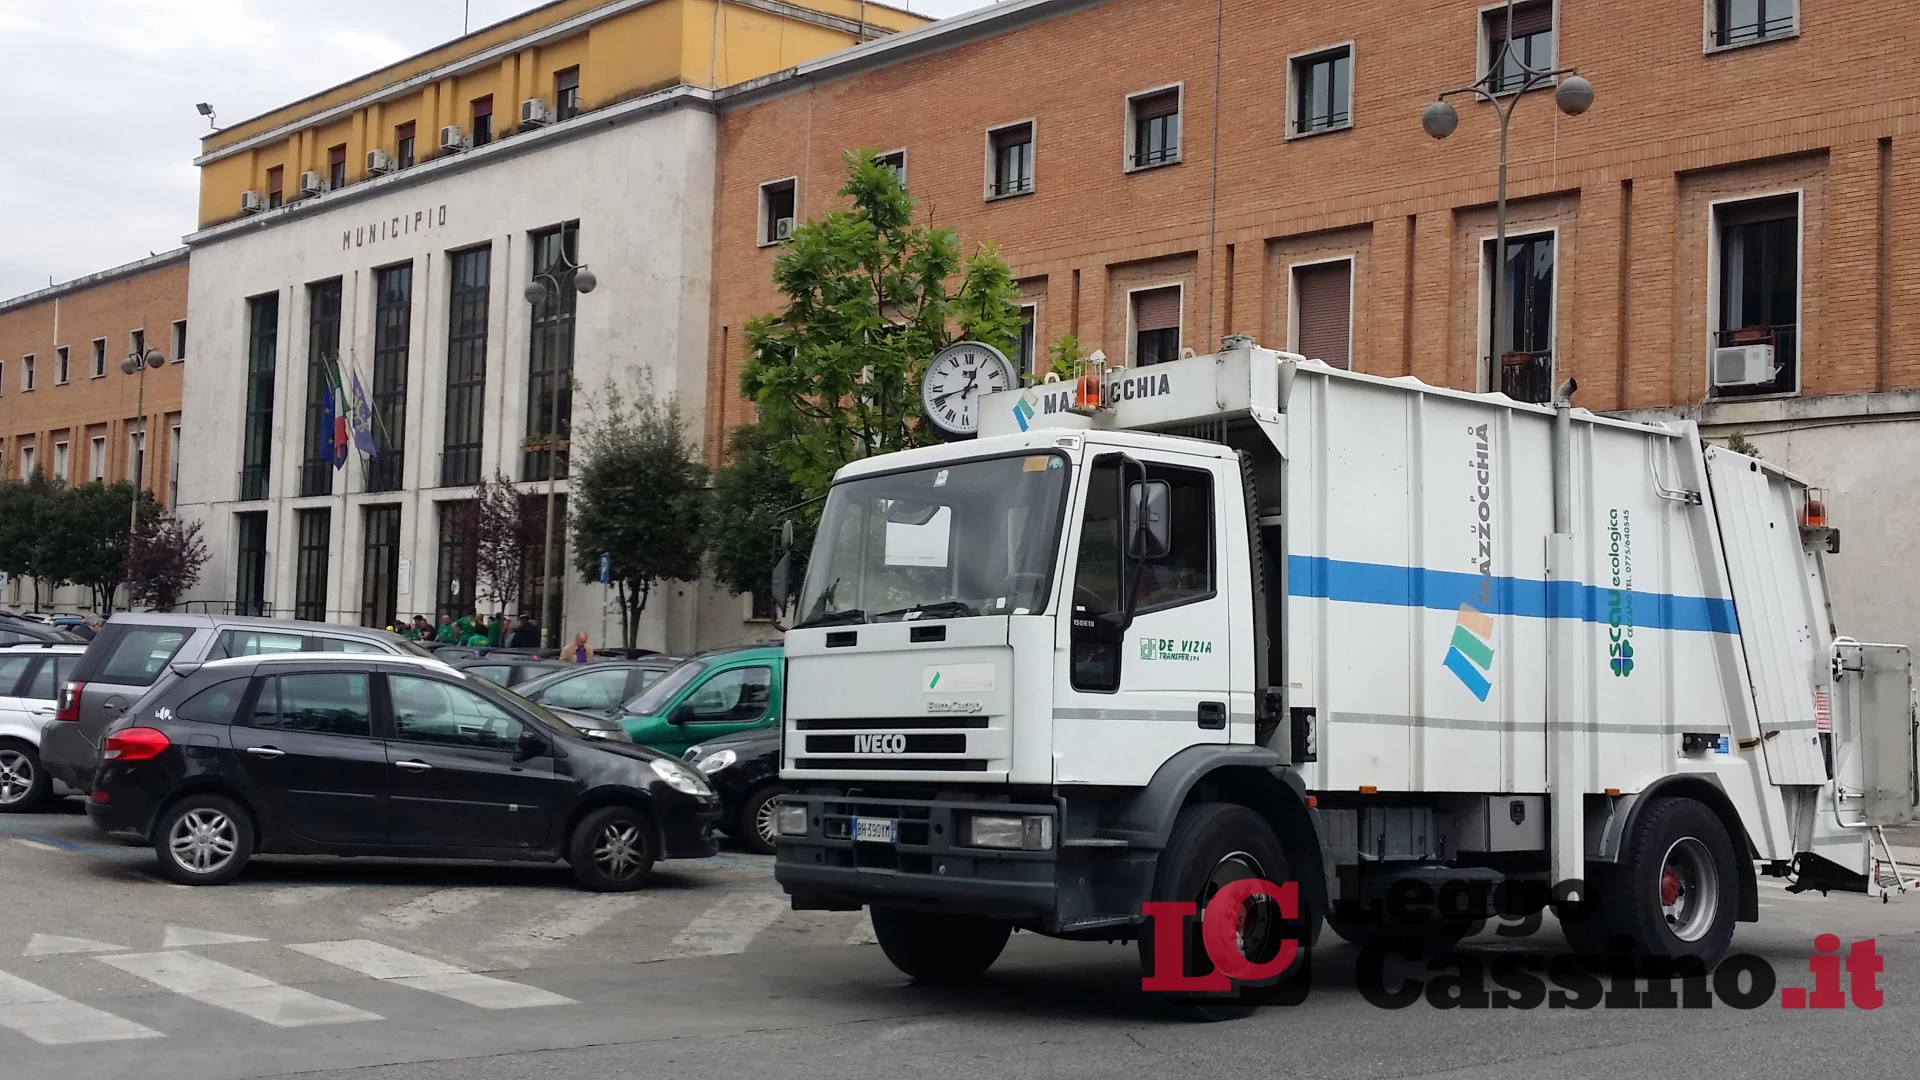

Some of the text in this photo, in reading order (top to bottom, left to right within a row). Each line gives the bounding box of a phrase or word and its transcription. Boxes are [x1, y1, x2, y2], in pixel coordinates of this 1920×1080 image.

[343, 204, 447, 251] MUNICIPIO
[1043, 373, 1171, 415] MACCHIA
[1475, 423, 1492, 605] MAZZOCCHIA
[1607, 508, 1622, 587] ecologica
[1623, 509, 1632, 573] 0775/640545
[1073, 618, 1095, 628] 150E18
[1158, 639, 1212, 653] DE VIZIA
[1158, 652, 1189, 661] TRANSFER
[927, 701, 982, 713] EuroCargo
[854, 734, 907, 754] IVECO
